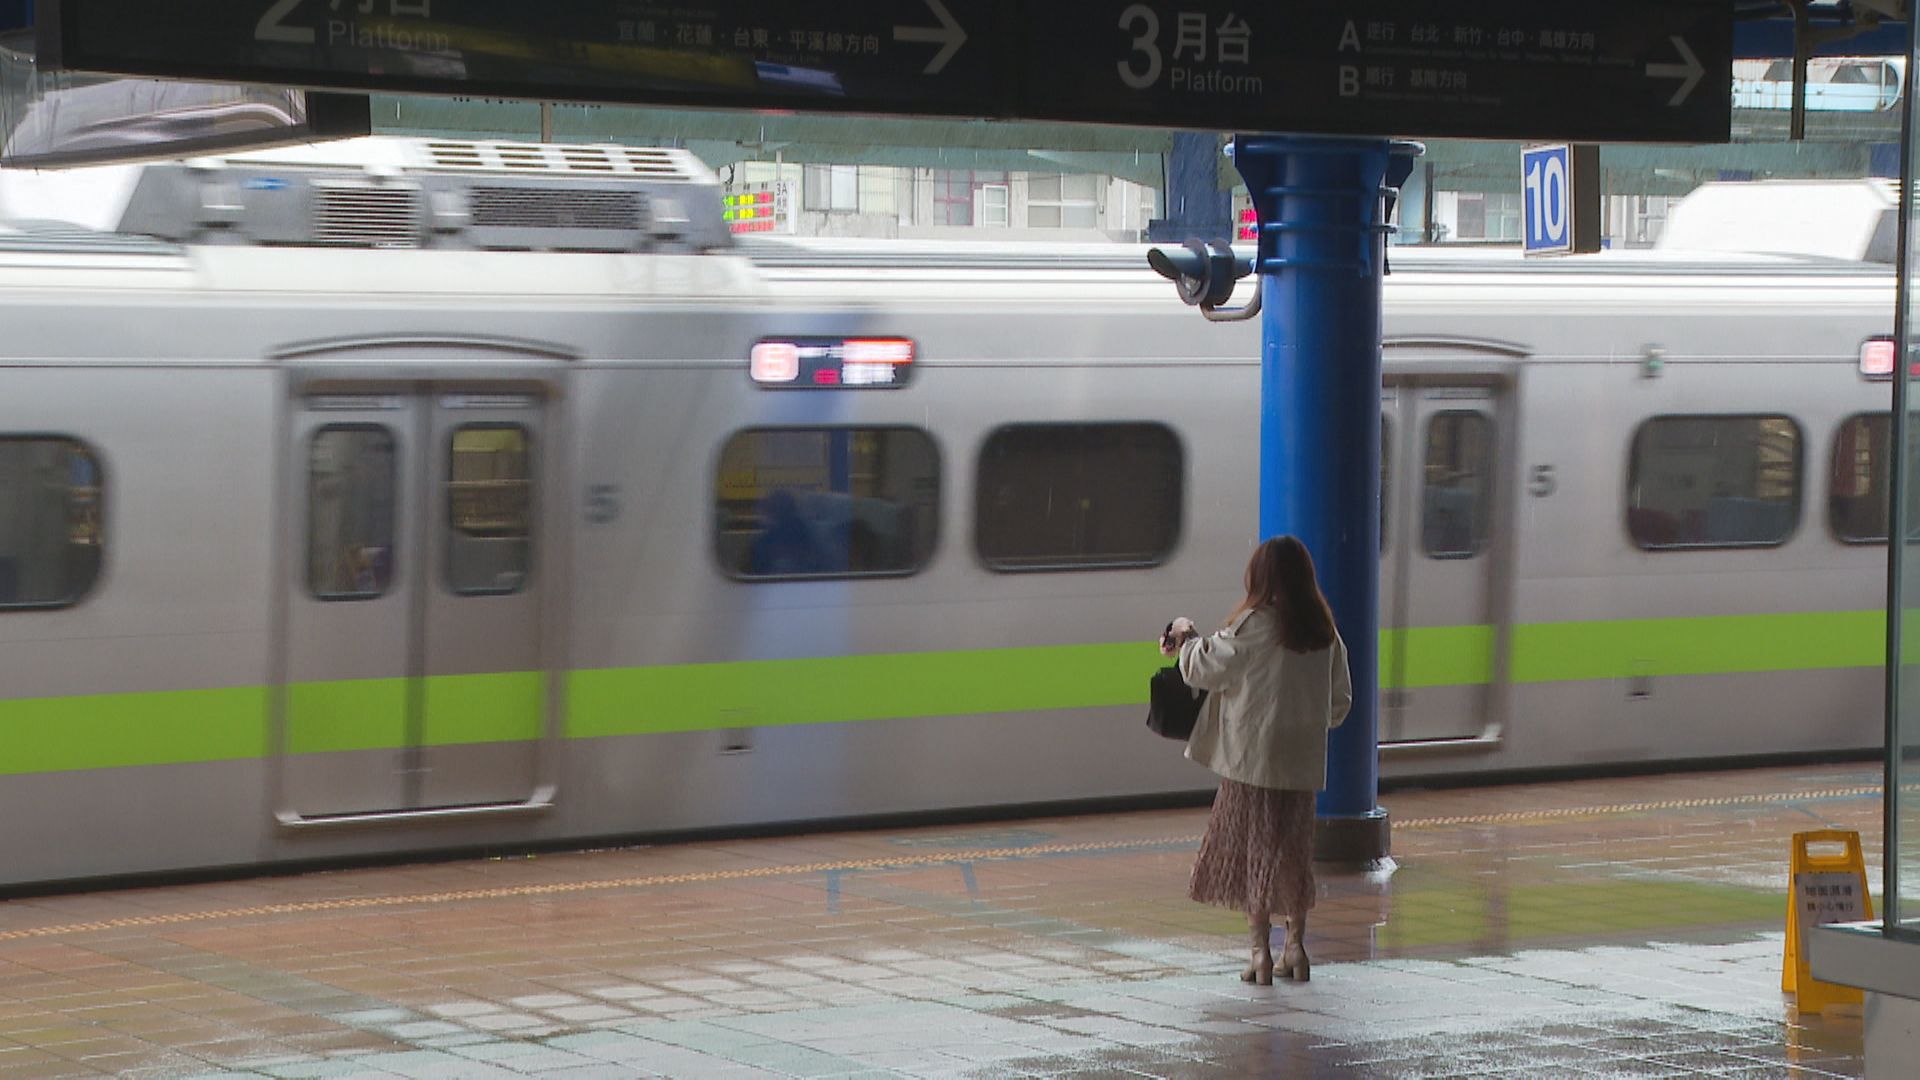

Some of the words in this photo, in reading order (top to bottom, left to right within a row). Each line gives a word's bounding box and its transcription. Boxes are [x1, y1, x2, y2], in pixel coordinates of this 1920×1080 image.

[328, 20, 449, 51] Platform
[1117, 3, 1163, 89] 3
[1171, 11, 1253, 65] 月台
[1337, 19, 1362, 53] A
[1170, 66, 1263, 96] Platform
[1337, 64, 1361, 97] B
[1526, 155, 1566, 243] 10
[1528, 465, 1557, 497] 5
[584, 486, 620, 522] 5
